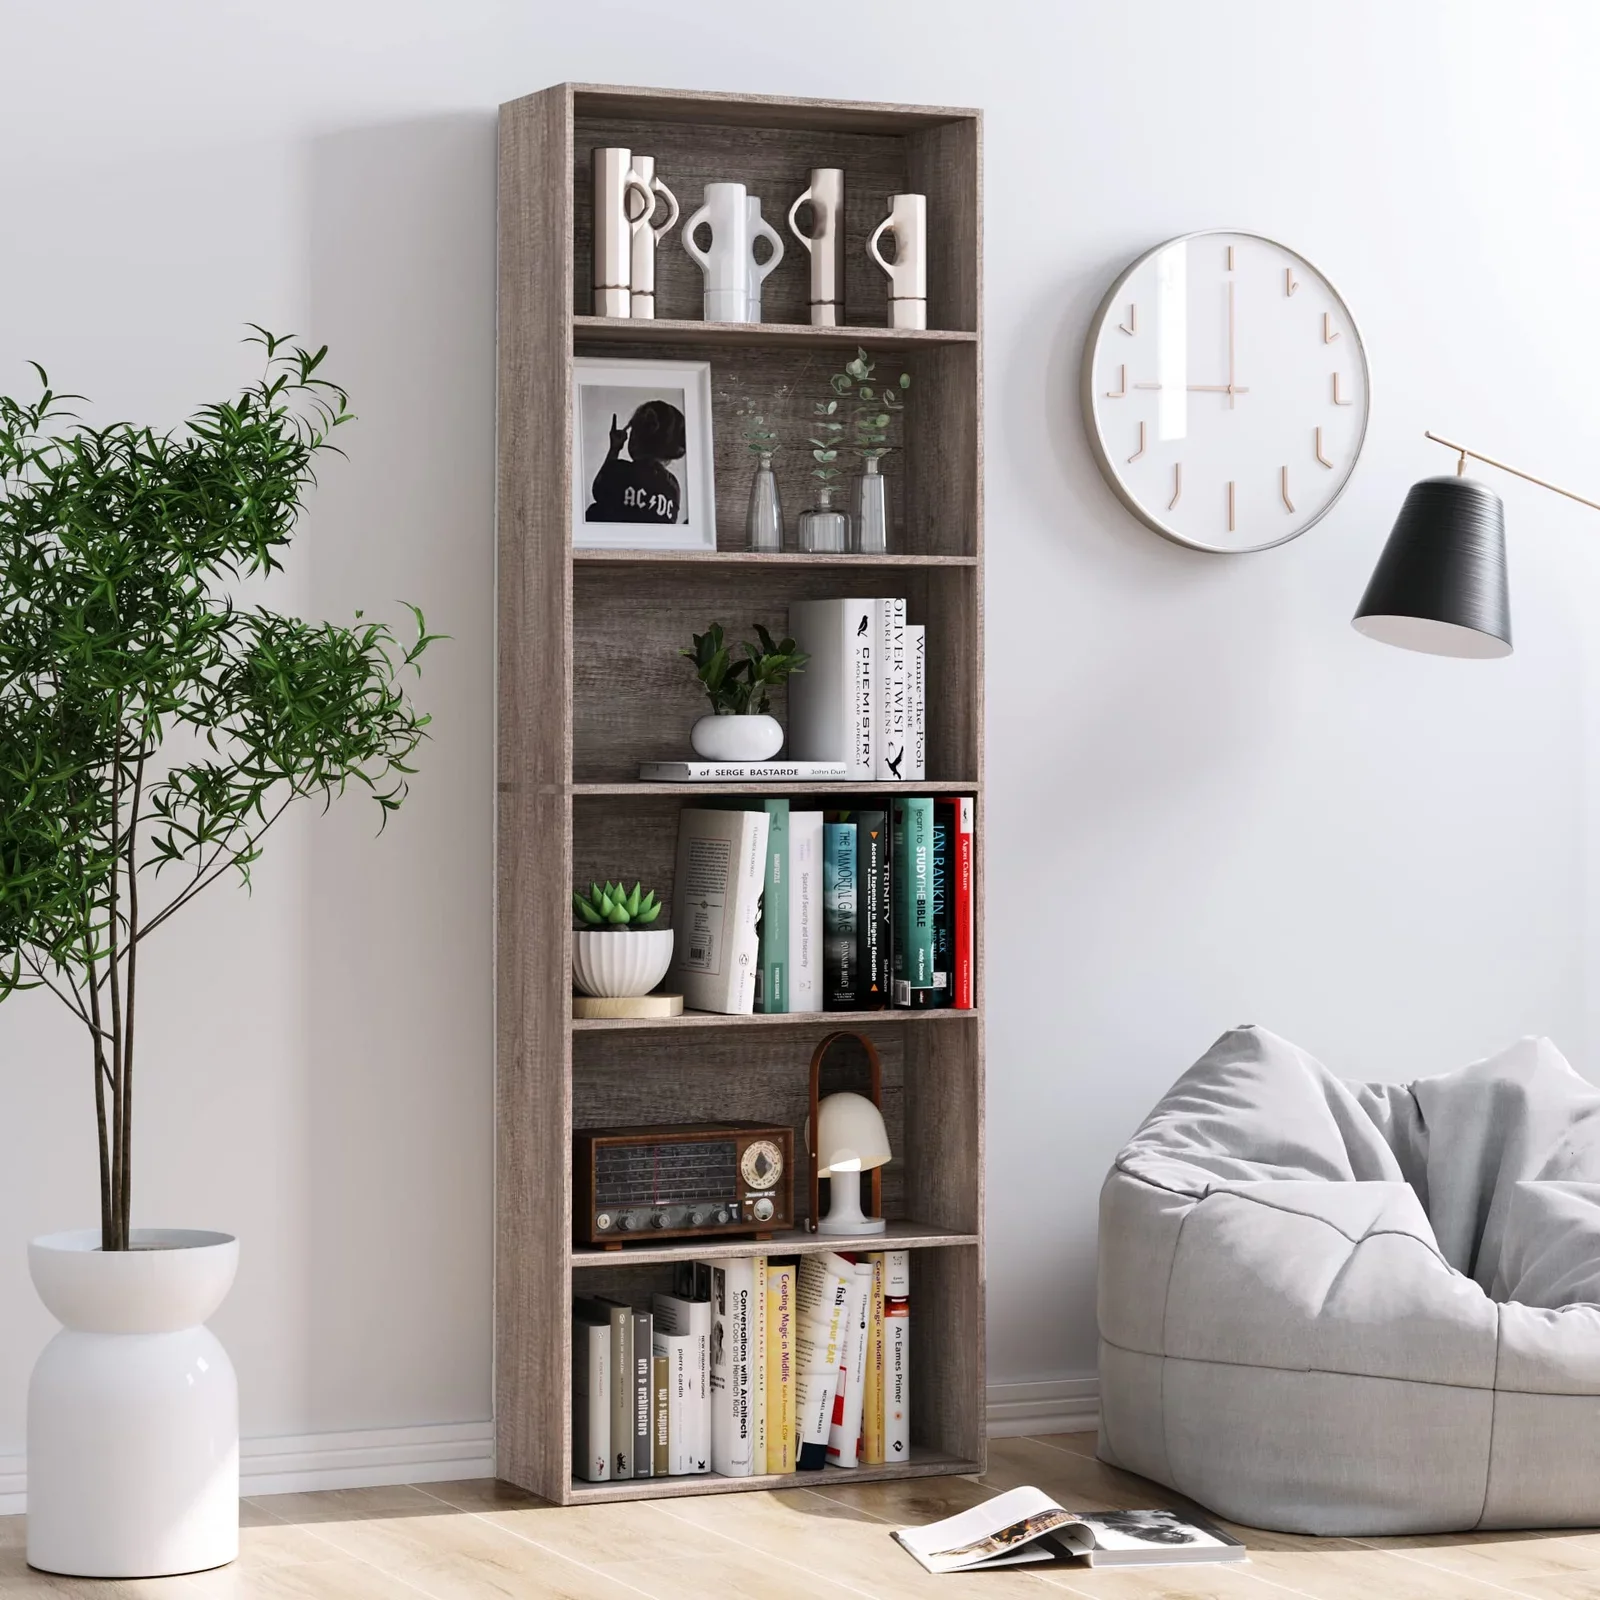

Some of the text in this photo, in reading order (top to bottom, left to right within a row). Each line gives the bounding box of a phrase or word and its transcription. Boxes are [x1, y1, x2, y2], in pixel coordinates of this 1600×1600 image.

[894, 598, 904, 737] OLIVER TWIST
[862, 647, 870, 768] CHEMISTRY
[773, 853, 781, 884] BUMFUZZLE
[834, 831, 852, 932] THE IMMORTAL GAME
[913, 808, 926, 927] learn to STUDYTHEBIBLE
[933, 824, 945, 915] IAN RANKIN
[801, 901, 809, 925] Security
[801, 938, 809, 968] Insecurity
[874, 1261, 882, 1298] Creating
[732, 1291, 740, 1311] John
[834, 1287, 846, 1306] fish
[833, 1308, 843, 1317] in
[874, 1300, 882, 1326] Magic
[779, 1274, 790, 1382] Creating Magic in Midlife
[828, 1319, 840, 1341] your
[876, 1329, 882, 1337] in
[895, 1326, 903, 1339] An
[740, 1290, 748, 1439] Conversations with Architects
[825, 1344, 836, 1365] EAR
[895, 1374, 903, 1404] Primer
[732, 1399, 740, 1418] Klotz
